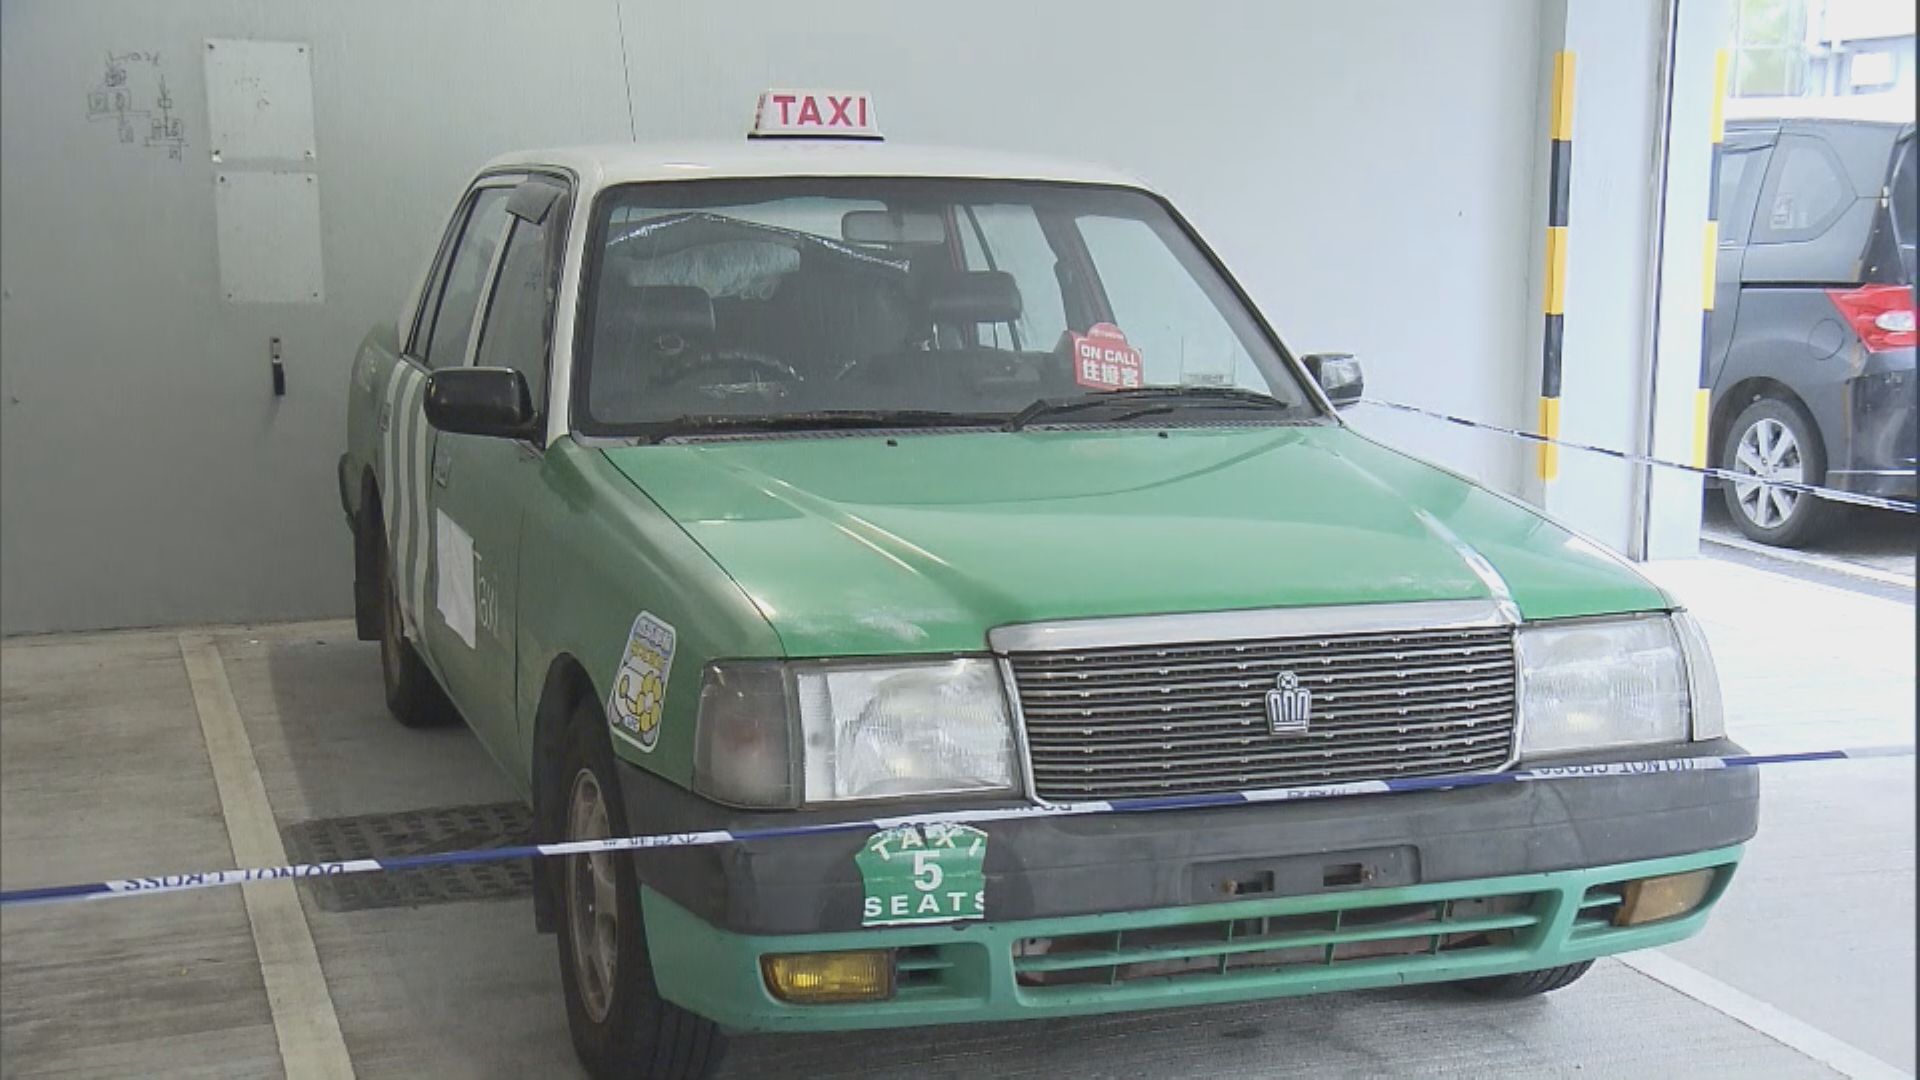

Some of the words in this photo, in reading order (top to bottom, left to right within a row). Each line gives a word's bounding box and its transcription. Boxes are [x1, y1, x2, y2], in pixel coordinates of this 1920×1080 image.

[773, 95, 866, 127] TAXI
[1081, 344, 1101, 360] ON
[1104, 349, 1138, 366] CALL
[871, 824, 983, 861] TAXI
[913, 850, 943, 892] 5
